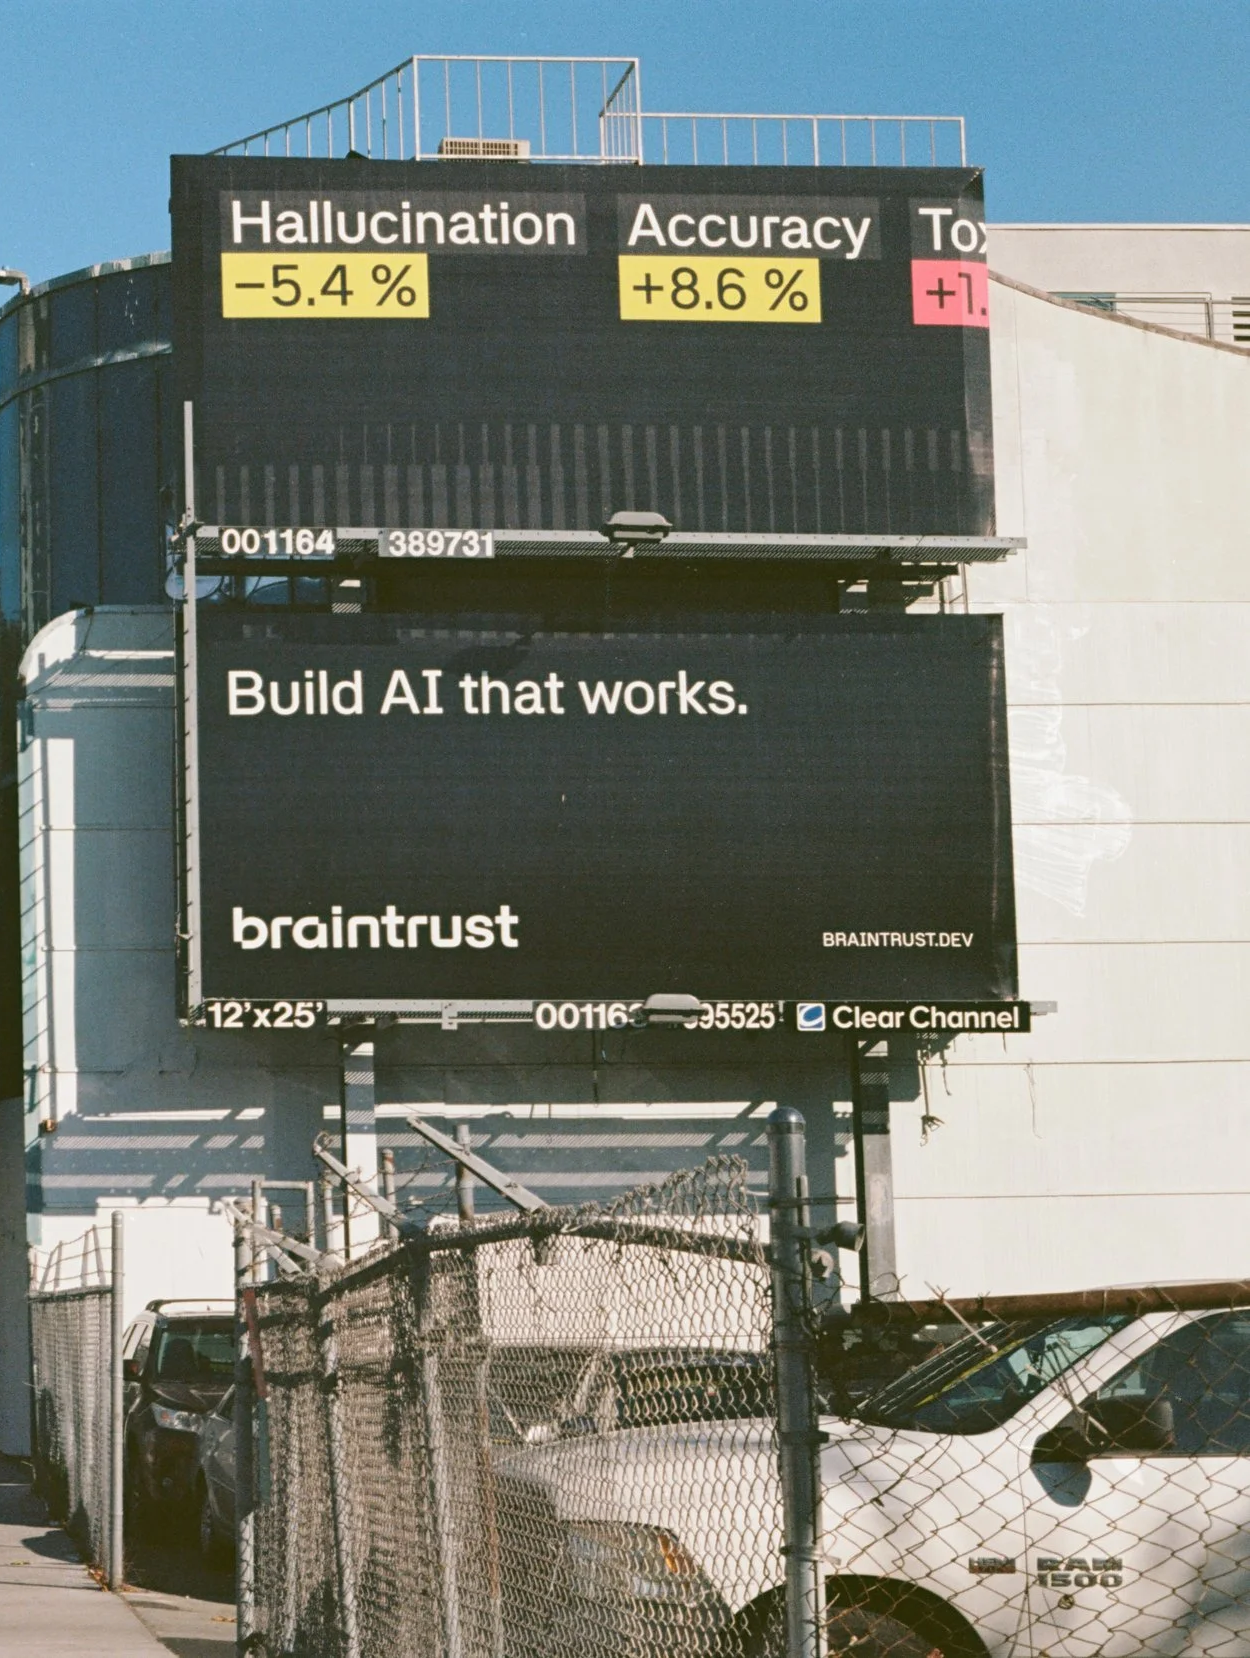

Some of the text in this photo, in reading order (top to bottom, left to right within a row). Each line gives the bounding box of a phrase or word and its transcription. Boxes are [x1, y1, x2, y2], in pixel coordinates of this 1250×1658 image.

[231, 199, 576, 246] Hallucination
[628, 202, 872, 258] Accuracy
[235, 264, 416, 307] -5.4 %
[632, 268, 808, 311] +8.6 %
[221, 528, 335, 555] 001164
[388, 530, 493, 557] 389731
[228, 669, 748, 716] Build AI that works.
[232, 904, 519, 950] braintrust
[822, 931, 974, 948] BRAINTRUST.DEV
[832, 1005, 1019, 1029] Clear Channel
[1037, 1557, 1123, 1572] RAM
[1037, 1572, 1123, 1588] 1500
